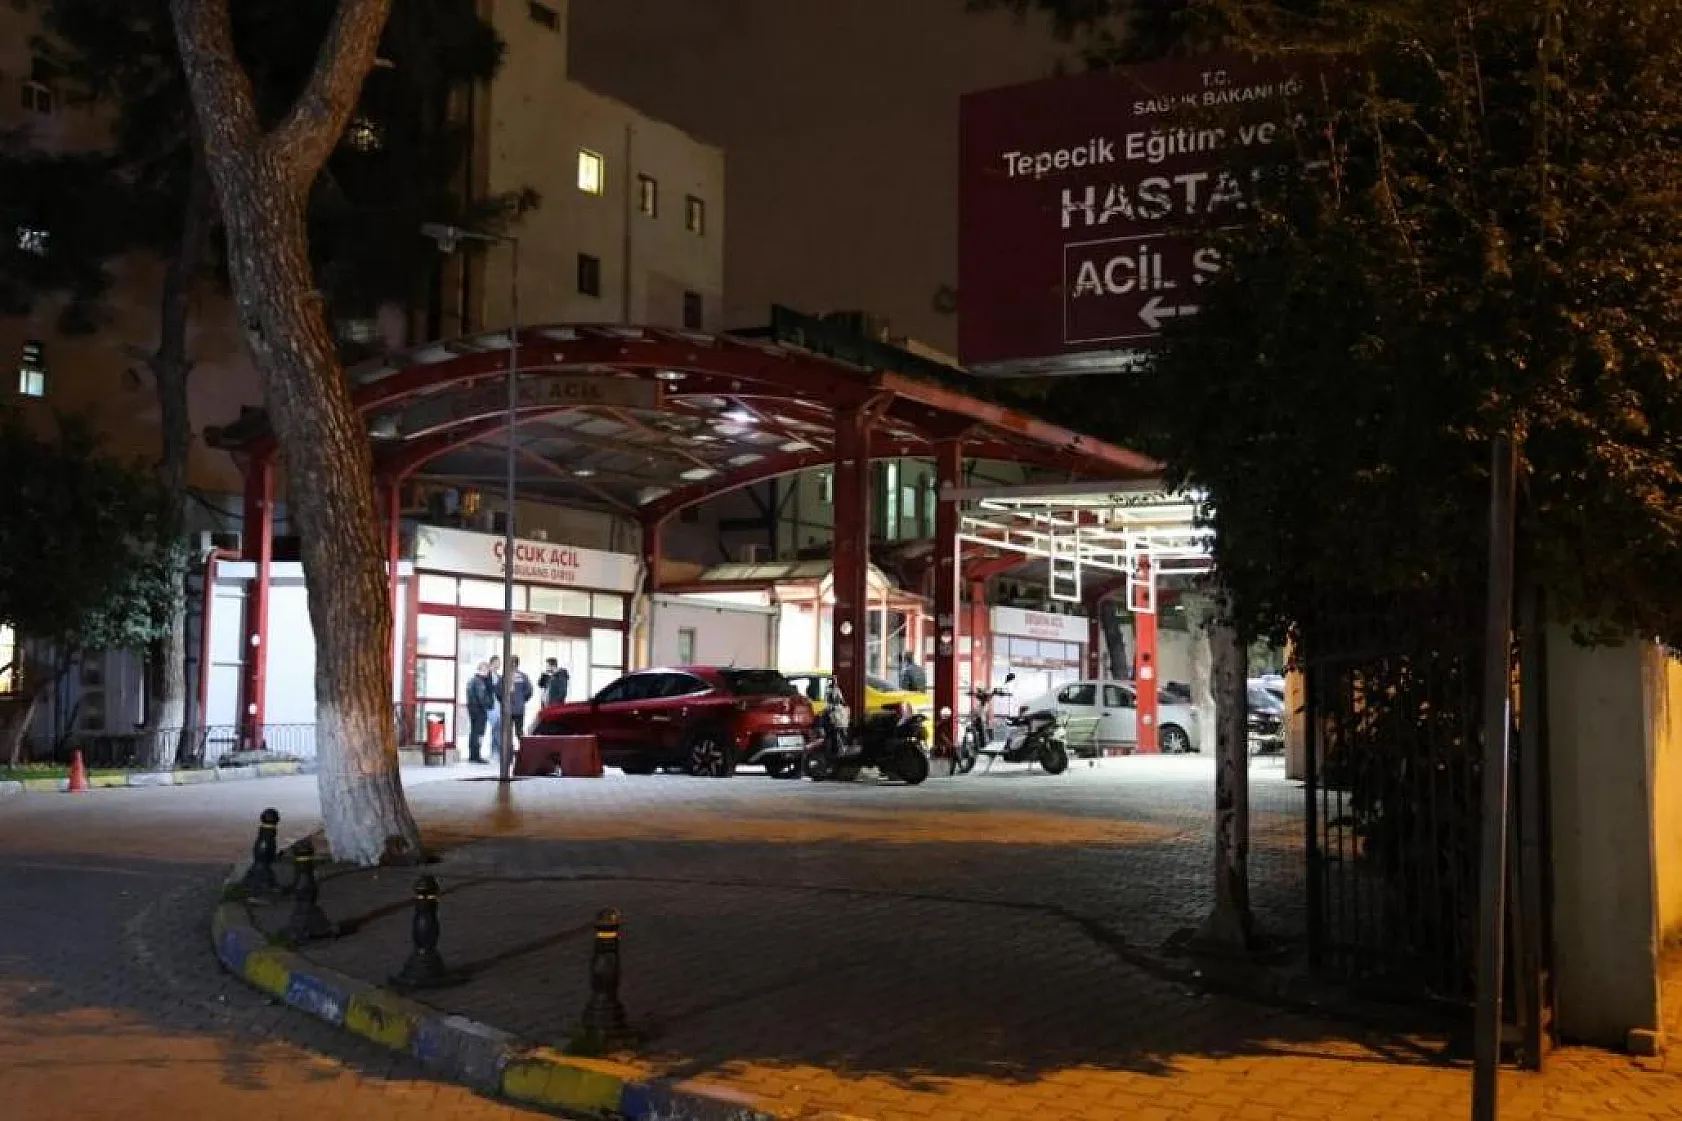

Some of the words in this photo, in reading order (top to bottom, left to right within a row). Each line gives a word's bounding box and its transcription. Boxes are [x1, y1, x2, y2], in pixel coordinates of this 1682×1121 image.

[1132, 91, 1199, 116] SAIK
[1002, 135, 1116, 181] Tepecik
[1237, 121, 1278, 147] ve
[1071, 244, 1179, 299] ACİL
[494, 541, 546, 563] ÇCUK
